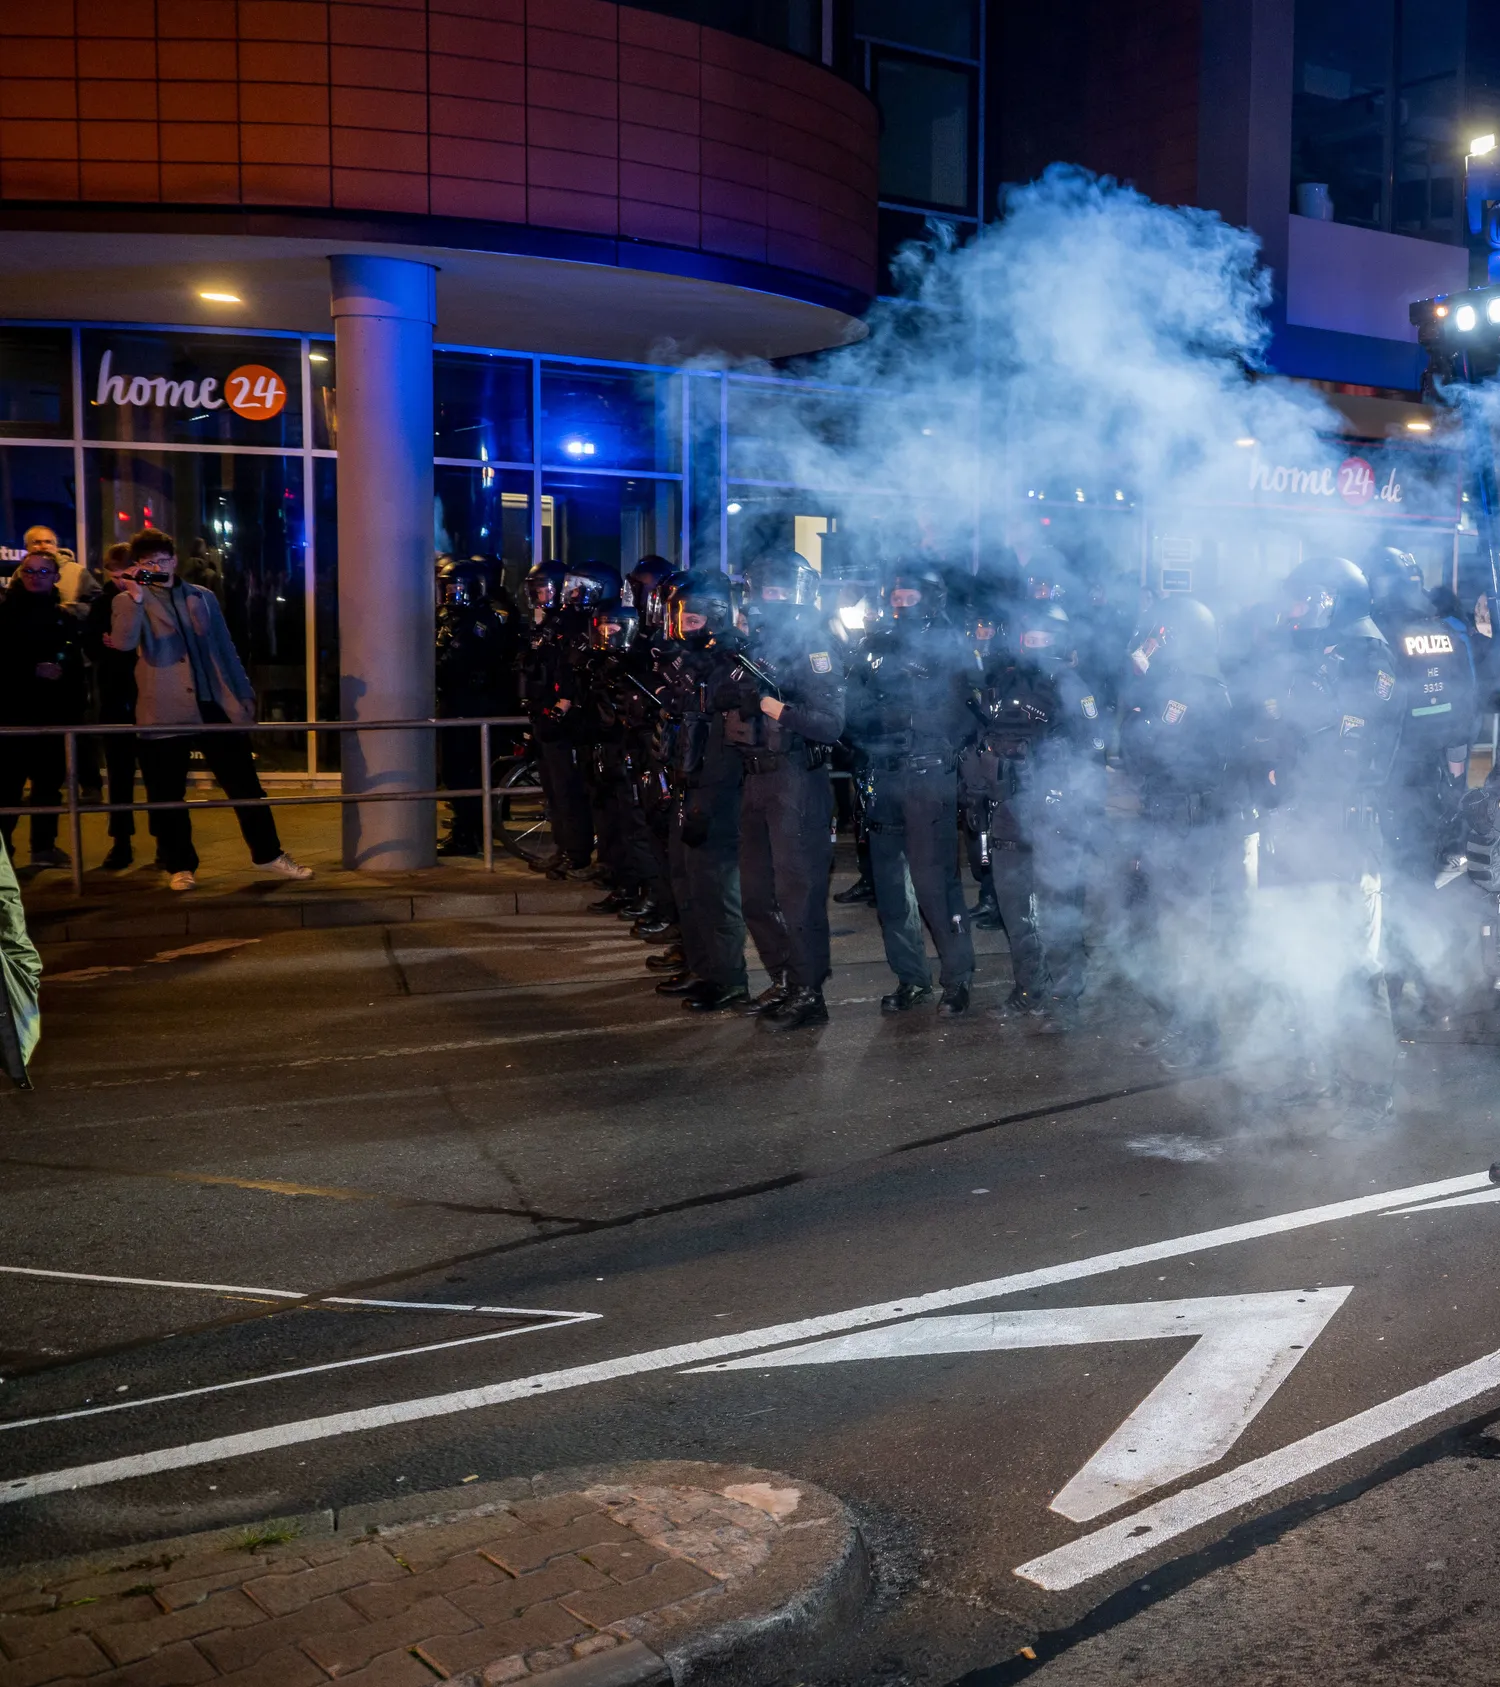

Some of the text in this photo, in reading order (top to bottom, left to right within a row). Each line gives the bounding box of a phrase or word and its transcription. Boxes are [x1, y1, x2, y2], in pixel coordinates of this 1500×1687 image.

[1404, 634, 1453, 655] POLIZEI
[1427, 667, 1439, 677] HE
[1424, 682, 1444, 693] 3313
